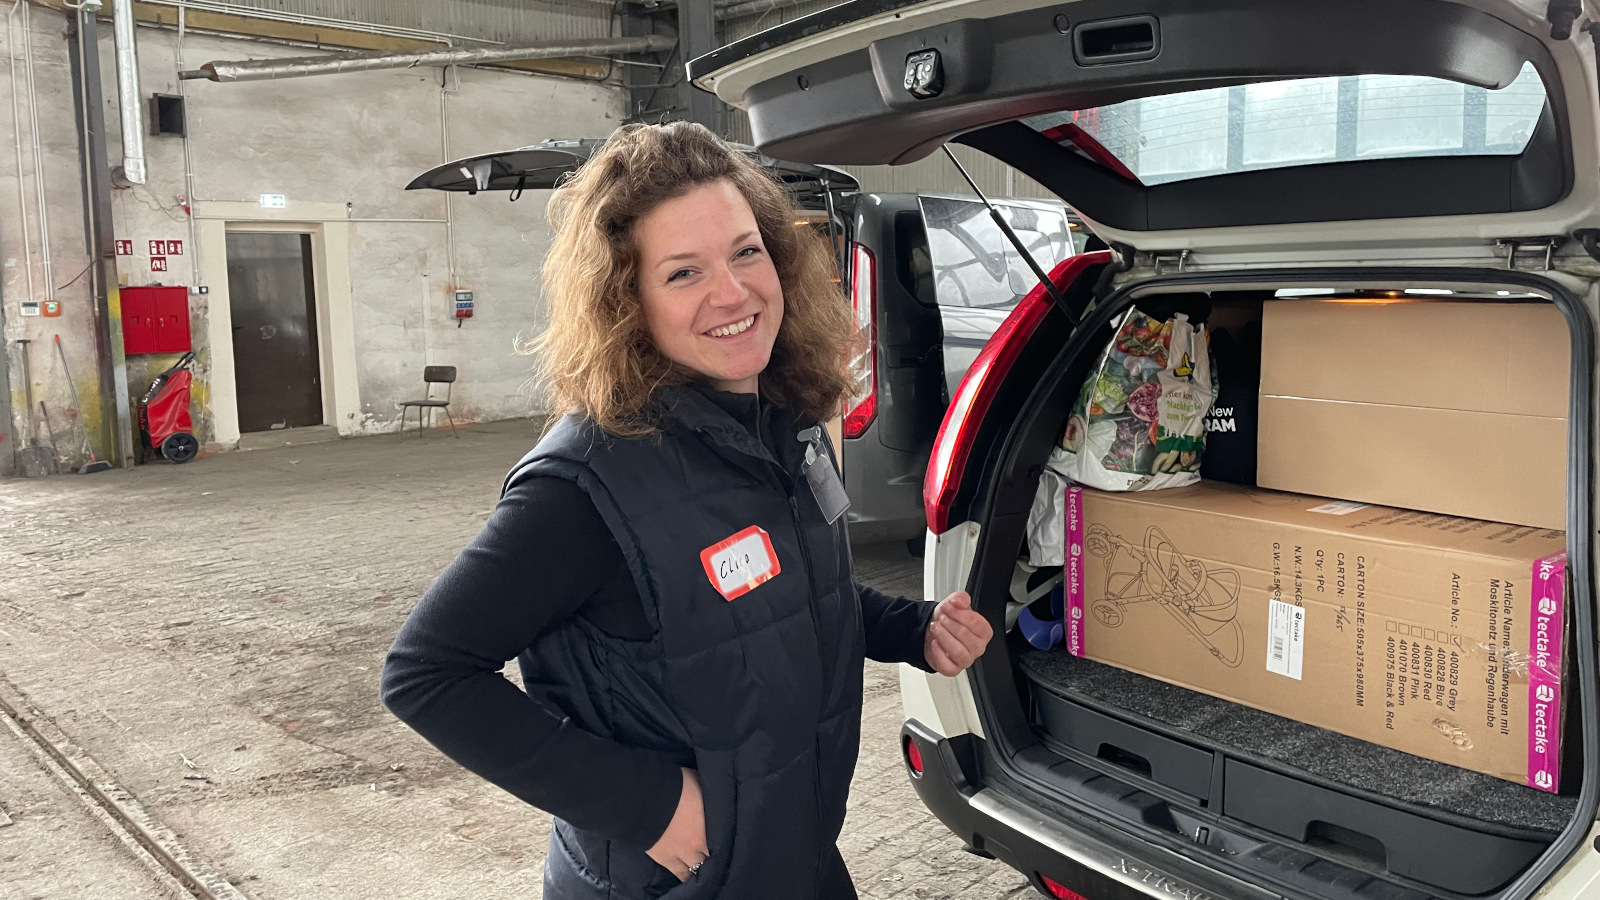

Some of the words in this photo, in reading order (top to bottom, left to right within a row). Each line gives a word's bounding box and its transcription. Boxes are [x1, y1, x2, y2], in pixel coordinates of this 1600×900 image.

[1069, 493, 1078, 531] tectake
[1070, 557, 1078, 595] tectake
[1315, 549, 1325, 571] Q'ty:
[1336, 551, 1345, 598] CARTON:
[1356, 555, 1365, 599] CARTON
[1316, 574, 1325, 593] 1PC
[1451, 572, 1461, 606] Article
[1504, 580, 1514, 615] Article
[1451, 608, 1460, 628] No.:
[1488, 578, 1500, 640] Moskitonetz
[1386, 636, 1395, 671] 400975
[1398, 639, 1407, 673] 401070
[1410, 641, 1420, 676] 400831
[1536, 616, 1550, 668] tectake
[1423, 644, 1433, 679] 400830
[1436, 647, 1446, 683] 400828
[1449, 651, 1459, 686] 400829
[1386, 672, 1395, 699] Black
[1398, 675, 1406, 706] Brown
[1410, 678, 1419, 699] Pink
[1423, 681, 1432, 701] Red
[1436, 685, 1445, 707] Blue
[1447, 688, 1458, 712] Grey
[1486, 664, 1498, 728] Regenhaube
[1386, 710, 1394, 730] Red
[1500, 719, 1509, 735] mit
[1535, 703, 1548, 754] tectake
